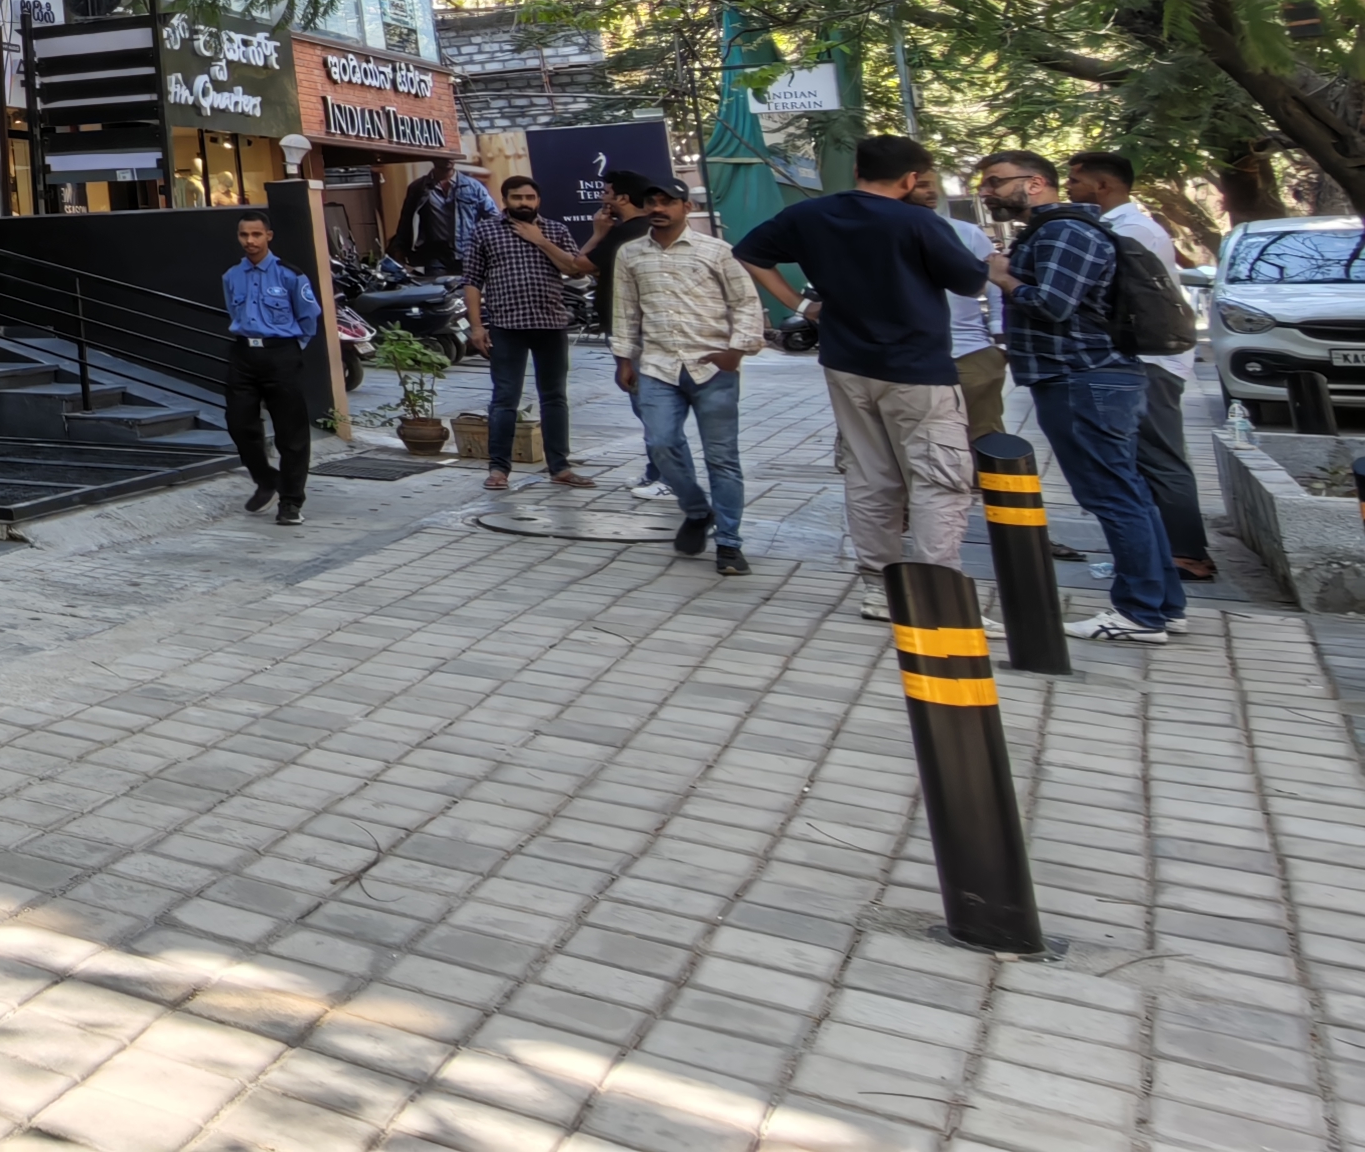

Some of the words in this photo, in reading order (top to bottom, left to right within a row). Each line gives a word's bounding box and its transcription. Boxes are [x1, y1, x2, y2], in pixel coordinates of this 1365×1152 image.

[193, 74, 262, 118] Quarters
[767, 89, 818, 101] INDIAN
[767, 100, 823, 111] TERRAIN
[321, 95, 386, 140] INDIAN
[383, 105, 446, 148] TERRAIN
[579, 179, 605, 190] IND
[563, 214, 594, 222] WHER
